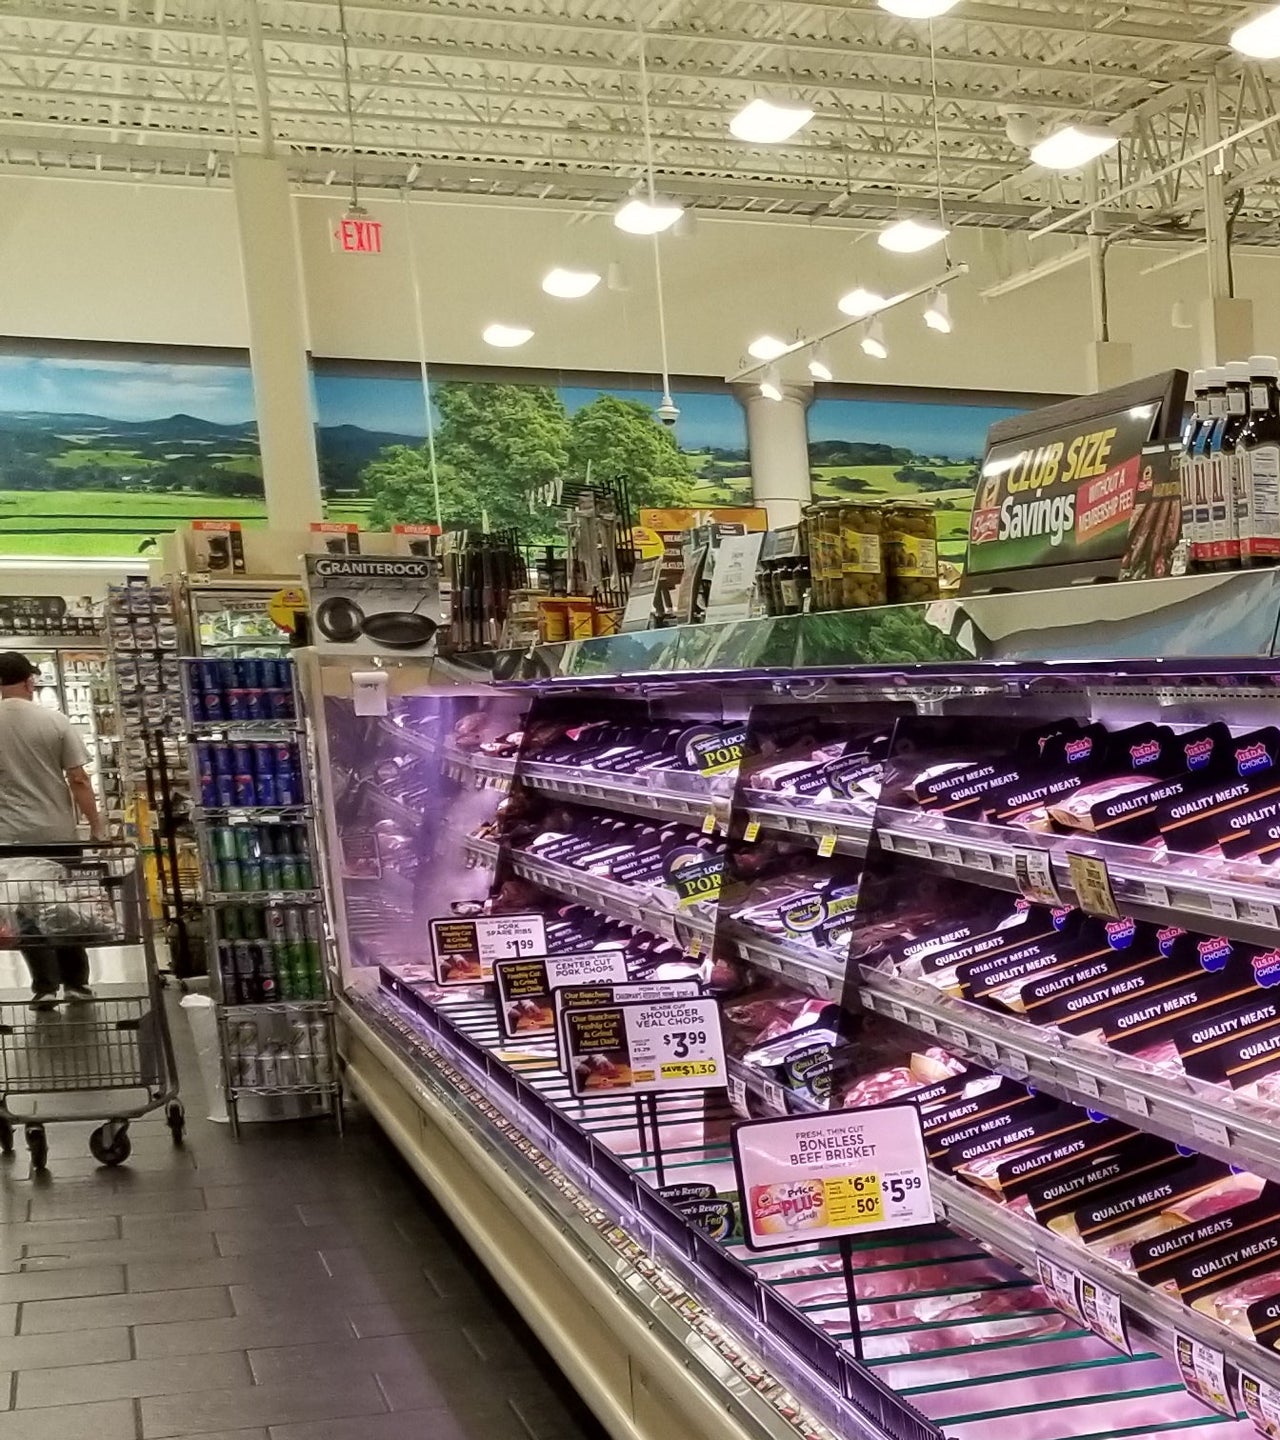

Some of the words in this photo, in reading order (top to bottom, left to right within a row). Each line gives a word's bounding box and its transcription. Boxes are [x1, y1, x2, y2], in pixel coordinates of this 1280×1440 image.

[341, 221, 381, 252] EXIT
[1007, 442, 1063, 493] CLUB
[1061, 428, 1117, 483] SIZE
[1000, 489, 1075, 546] Savings
[317, 560, 425, 575] GRANITEROCK
[1106, 793, 1152, 817] QUALITY
[1153, 783, 1184, 803] MEATS
[636, 1018, 665, 1028] VEAL
[668, 1016, 704, 1025] CHOPS
[640, 1009, 698, 1020] SHOULDER
[790, 1151, 822, 1165] BEEF
[826, 1145, 876, 1161] BRISKET
[800, 1134, 864, 1151] BONELESS
[1011, 1152, 1055, 1175] QUALITY
[1057, 1140, 1085, 1158] MEATS
